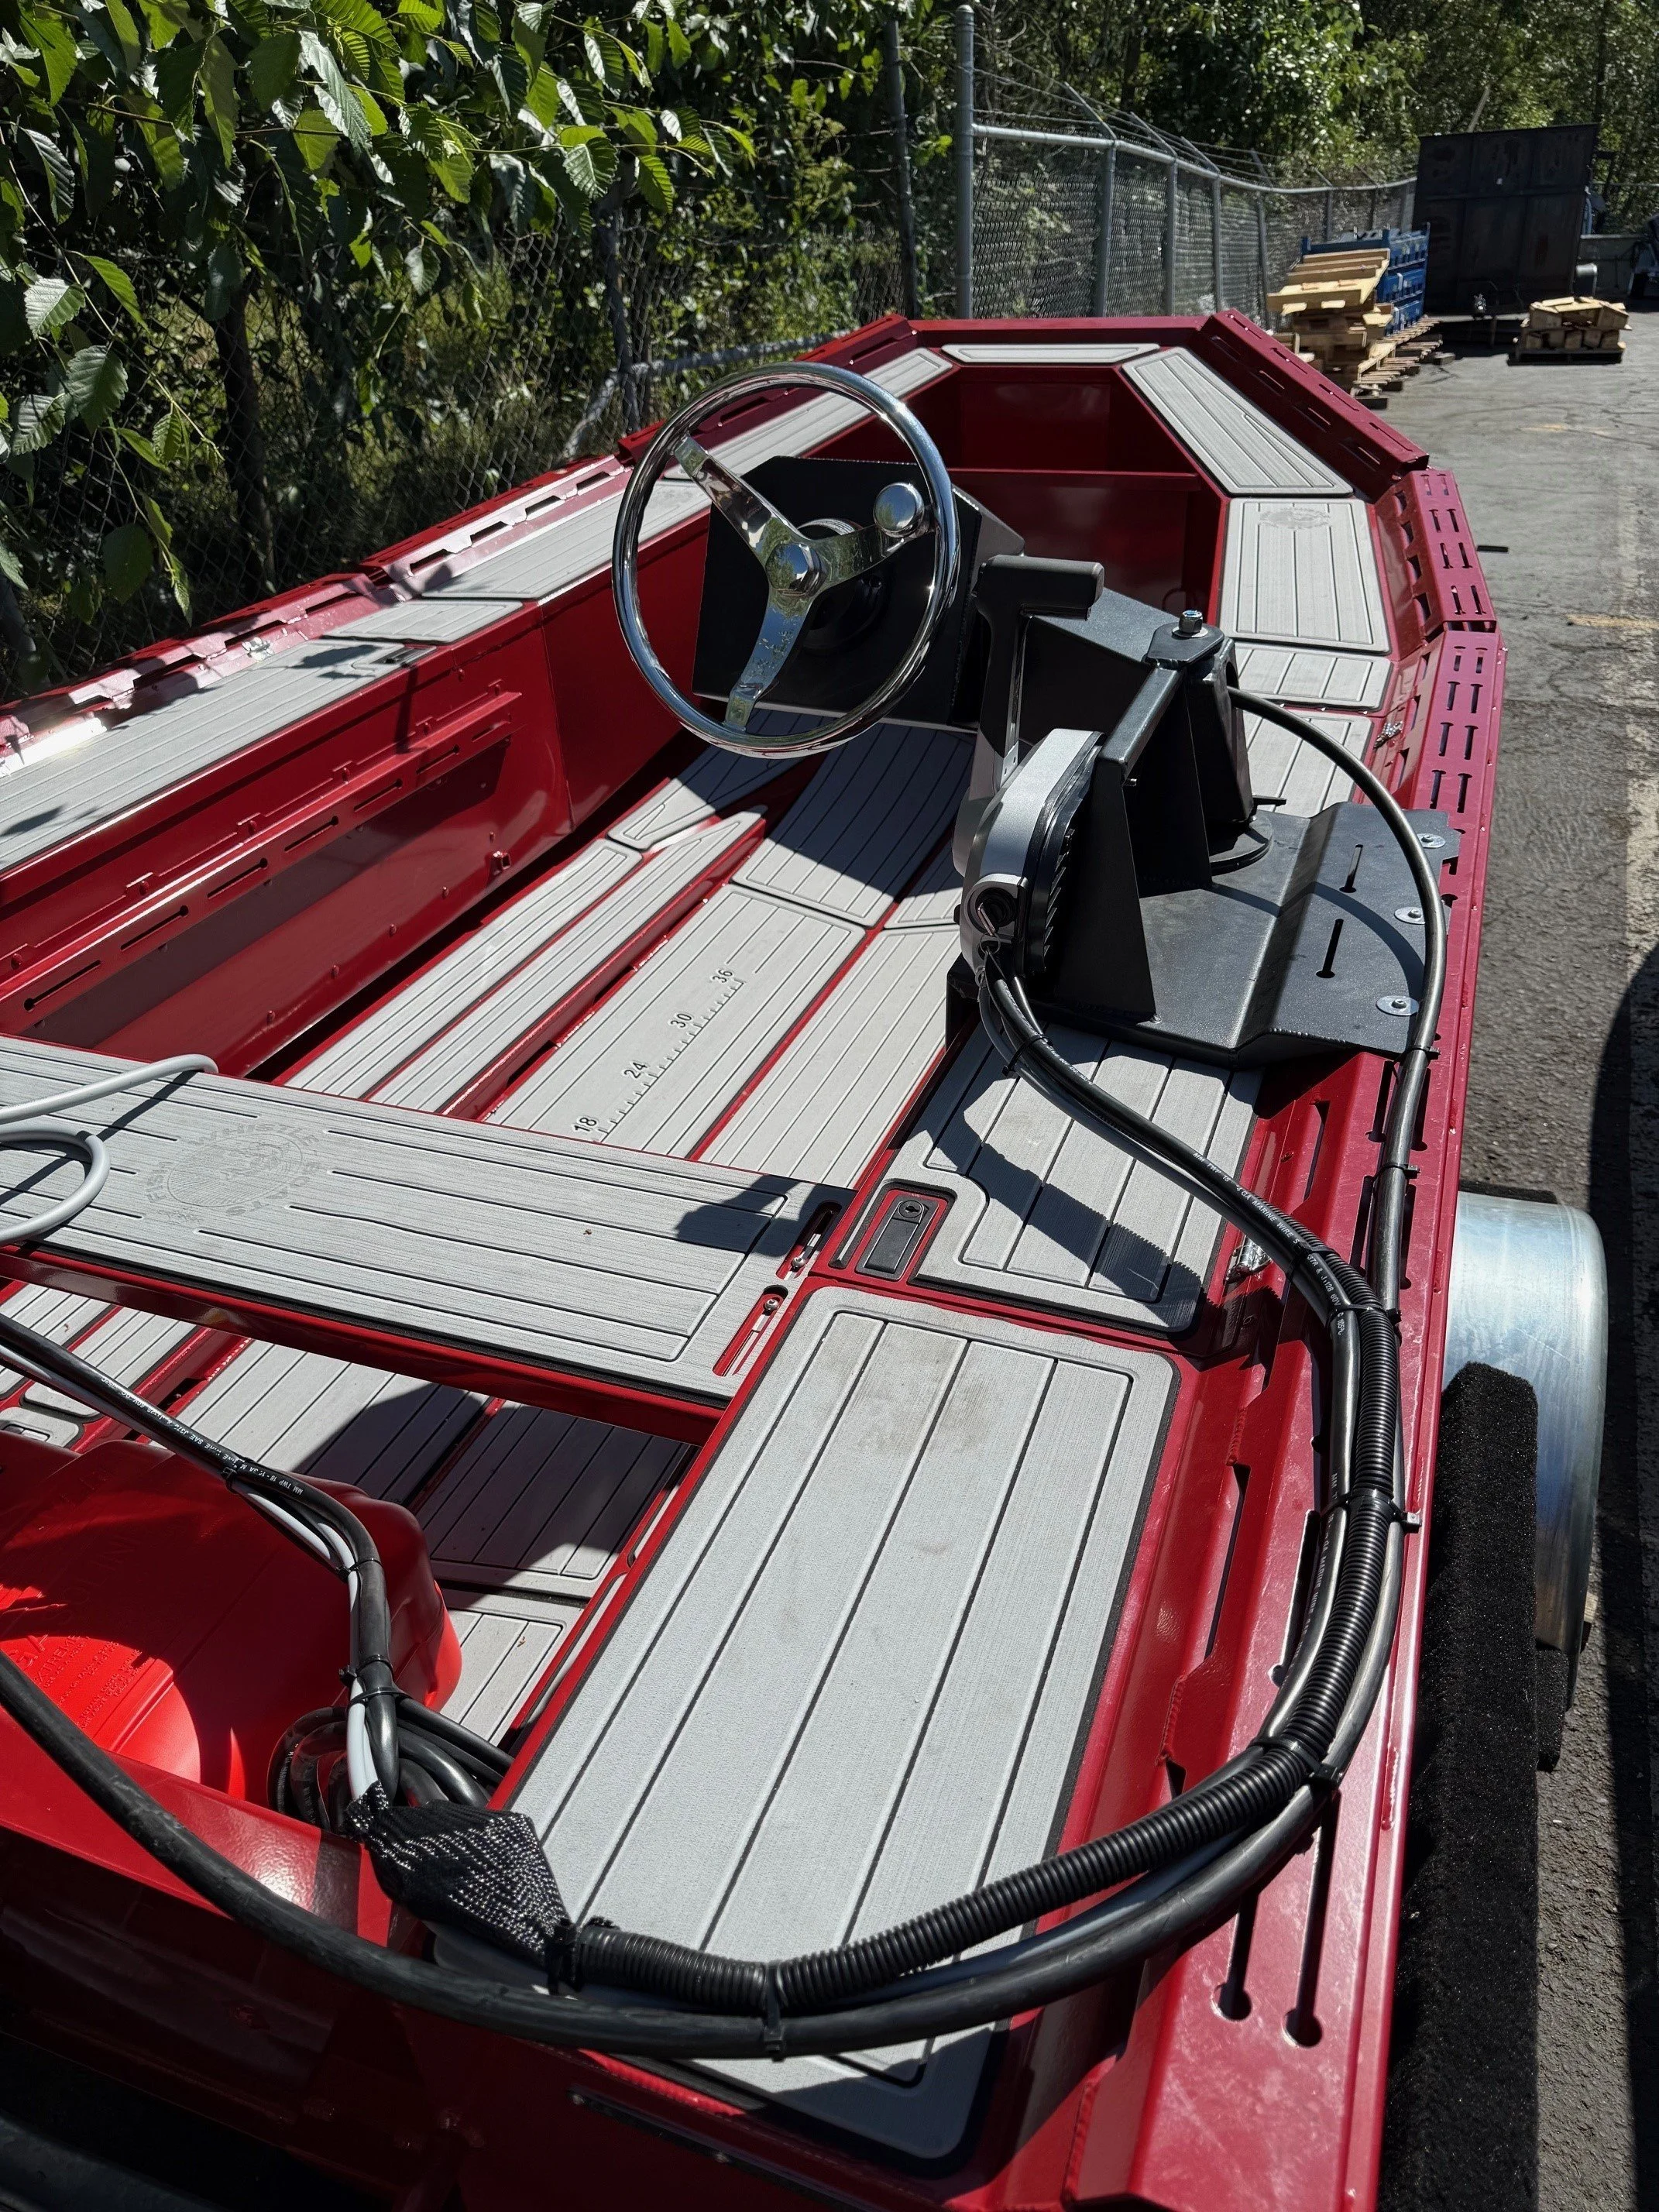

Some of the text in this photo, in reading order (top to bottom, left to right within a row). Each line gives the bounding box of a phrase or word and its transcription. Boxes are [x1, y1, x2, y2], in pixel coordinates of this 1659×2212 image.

[712, 969, 733, 984] 36
[670, 1013, 693, 1029] 30
[624, 1061, 647, 1079] 24
[574, 1117, 597, 1132] 18
[1251, 1198, 1276, 1222] MARINE
[1276, 1221, 1293, 1238] WIRE
[1329, 1293, 1341, 1306] 60V
[188, 1433, 204, 1445] SAE
